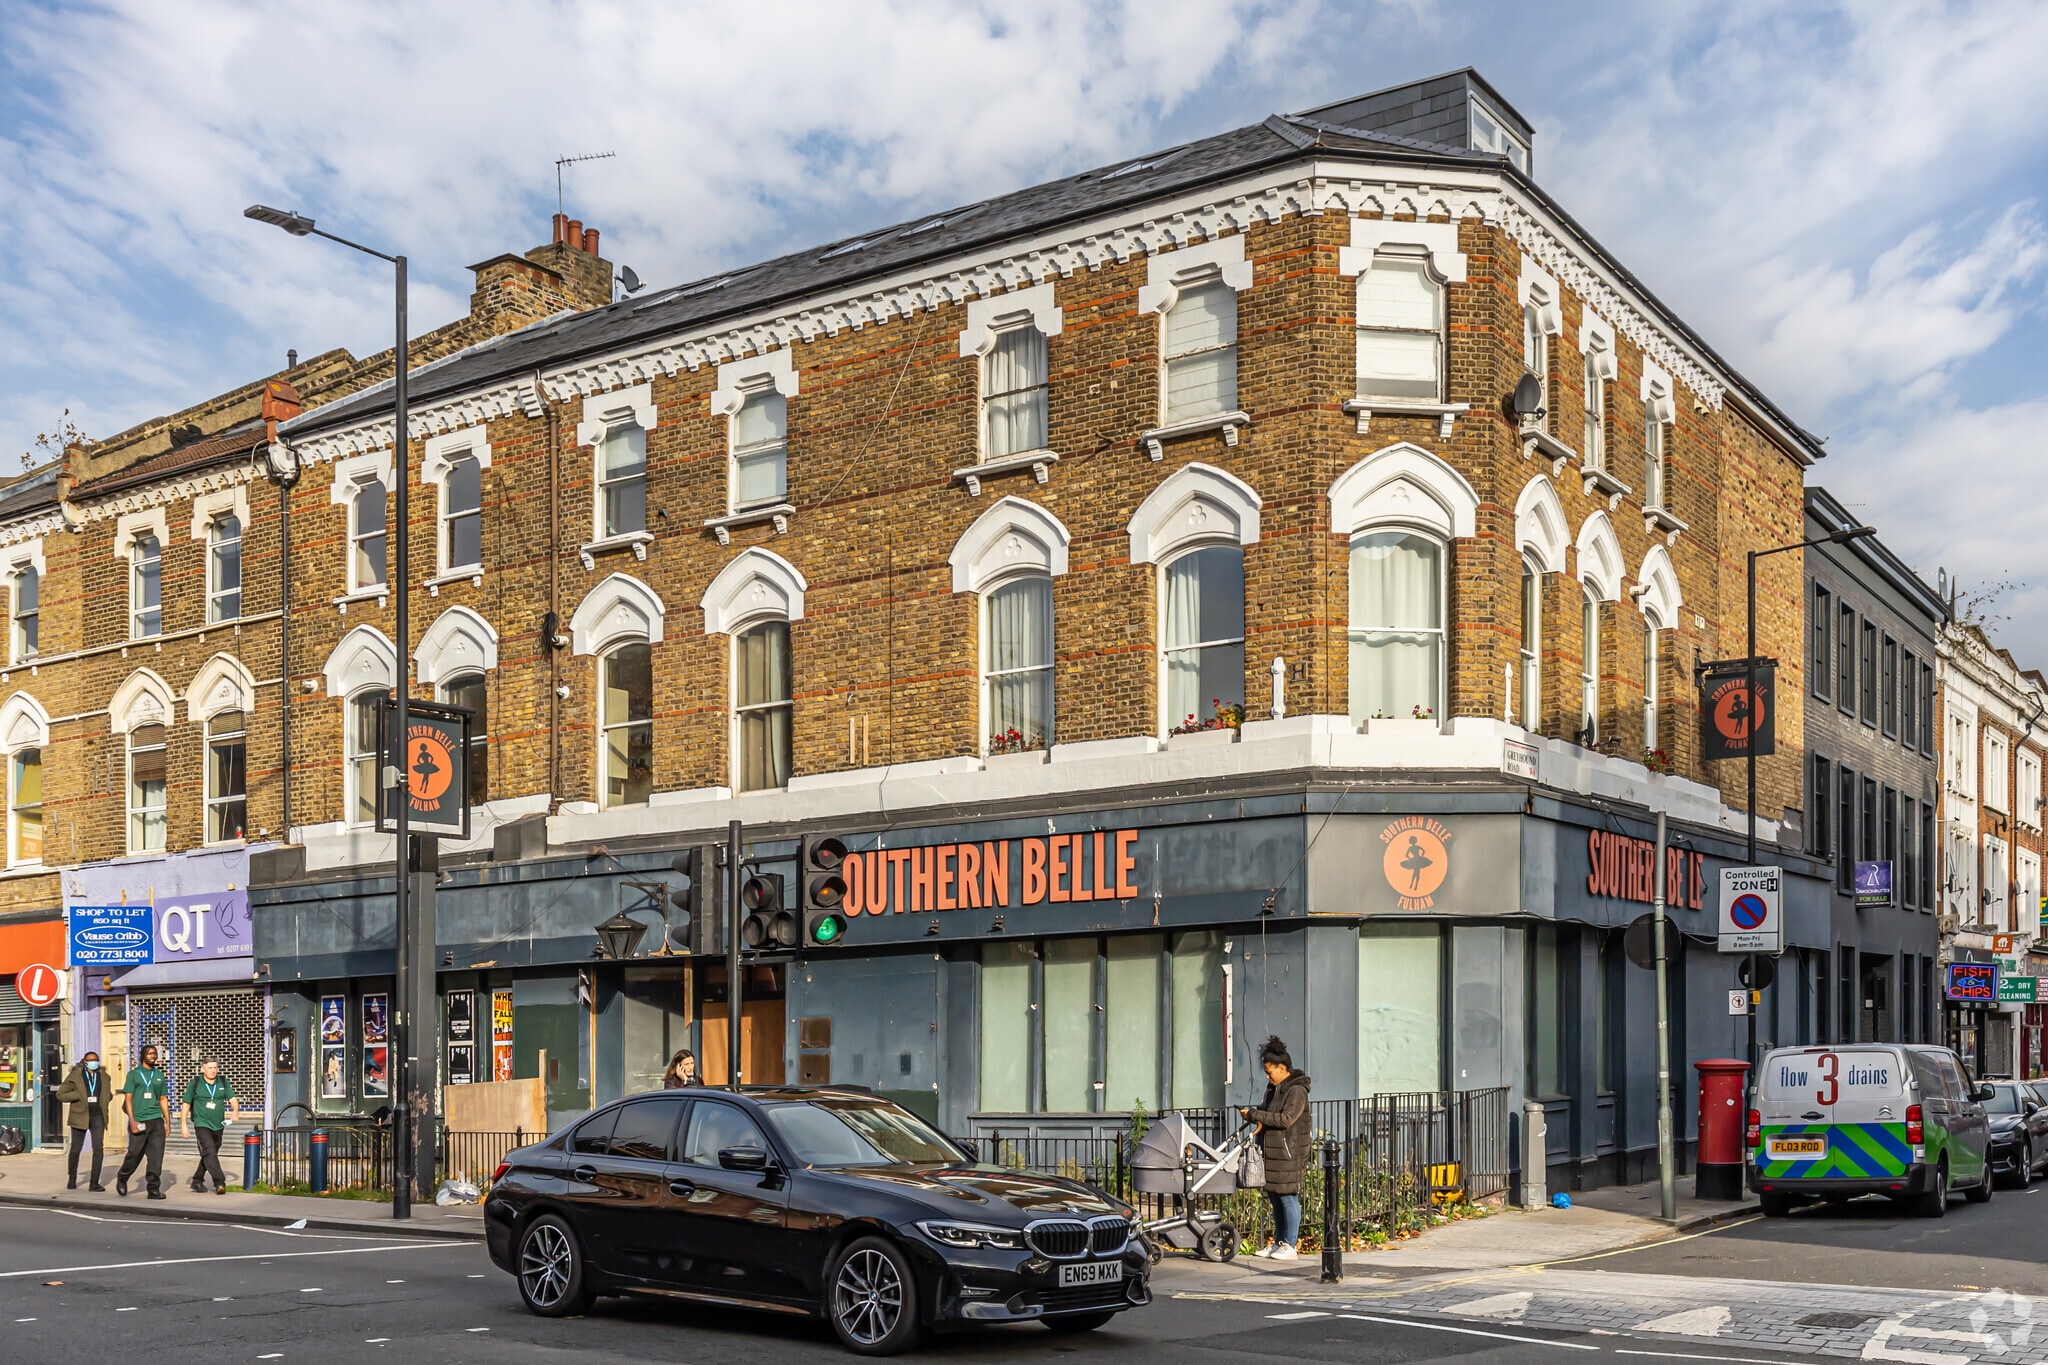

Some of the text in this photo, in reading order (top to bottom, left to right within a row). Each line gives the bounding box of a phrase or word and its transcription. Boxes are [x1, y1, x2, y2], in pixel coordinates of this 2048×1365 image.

[1711, 679, 1746, 701] SOUTHERN
[434, 728, 457, 752] BELLE
[1725, 739, 1748, 749] FULHA
[409, 798, 440, 812] FULHAM
[1379, 816, 1452, 844] SOUTHERN BELLE
[842, 829, 1138, 918] OUTHERN BELLE
[1588, 829, 1704, 910] SOUTHER BELE
[1725, 870, 1775, 880] Controlled
[1732, 879, 1777, 891] ZONE H
[1396, 895, 1435, 911] FULHAM
[75, 908, 146, 917] SHOP TO LET
[111, 918, 122, 926] sq
[160, 904, 211, 954] QT
[82, 931, 143, 941] Vause Cribb
[76, 950, 148, 959] 020 7731 8001
[226, 944, 240, 953] 0207
[1953, 967, 1991, 977] FISH
[1949, 986, 1991, 998] CHIPS
[2018, 982, 2032, 990] DRY
[1998, 992, 2031, 1000] CLEANING
[1780, 1066, 1808, 1087] flow
[1817, 1053, 1839, 1106] 3
[1848, 1064, 1888, 1086] drains
[1065, 1262, 1119, 1283] EN69 MXK
